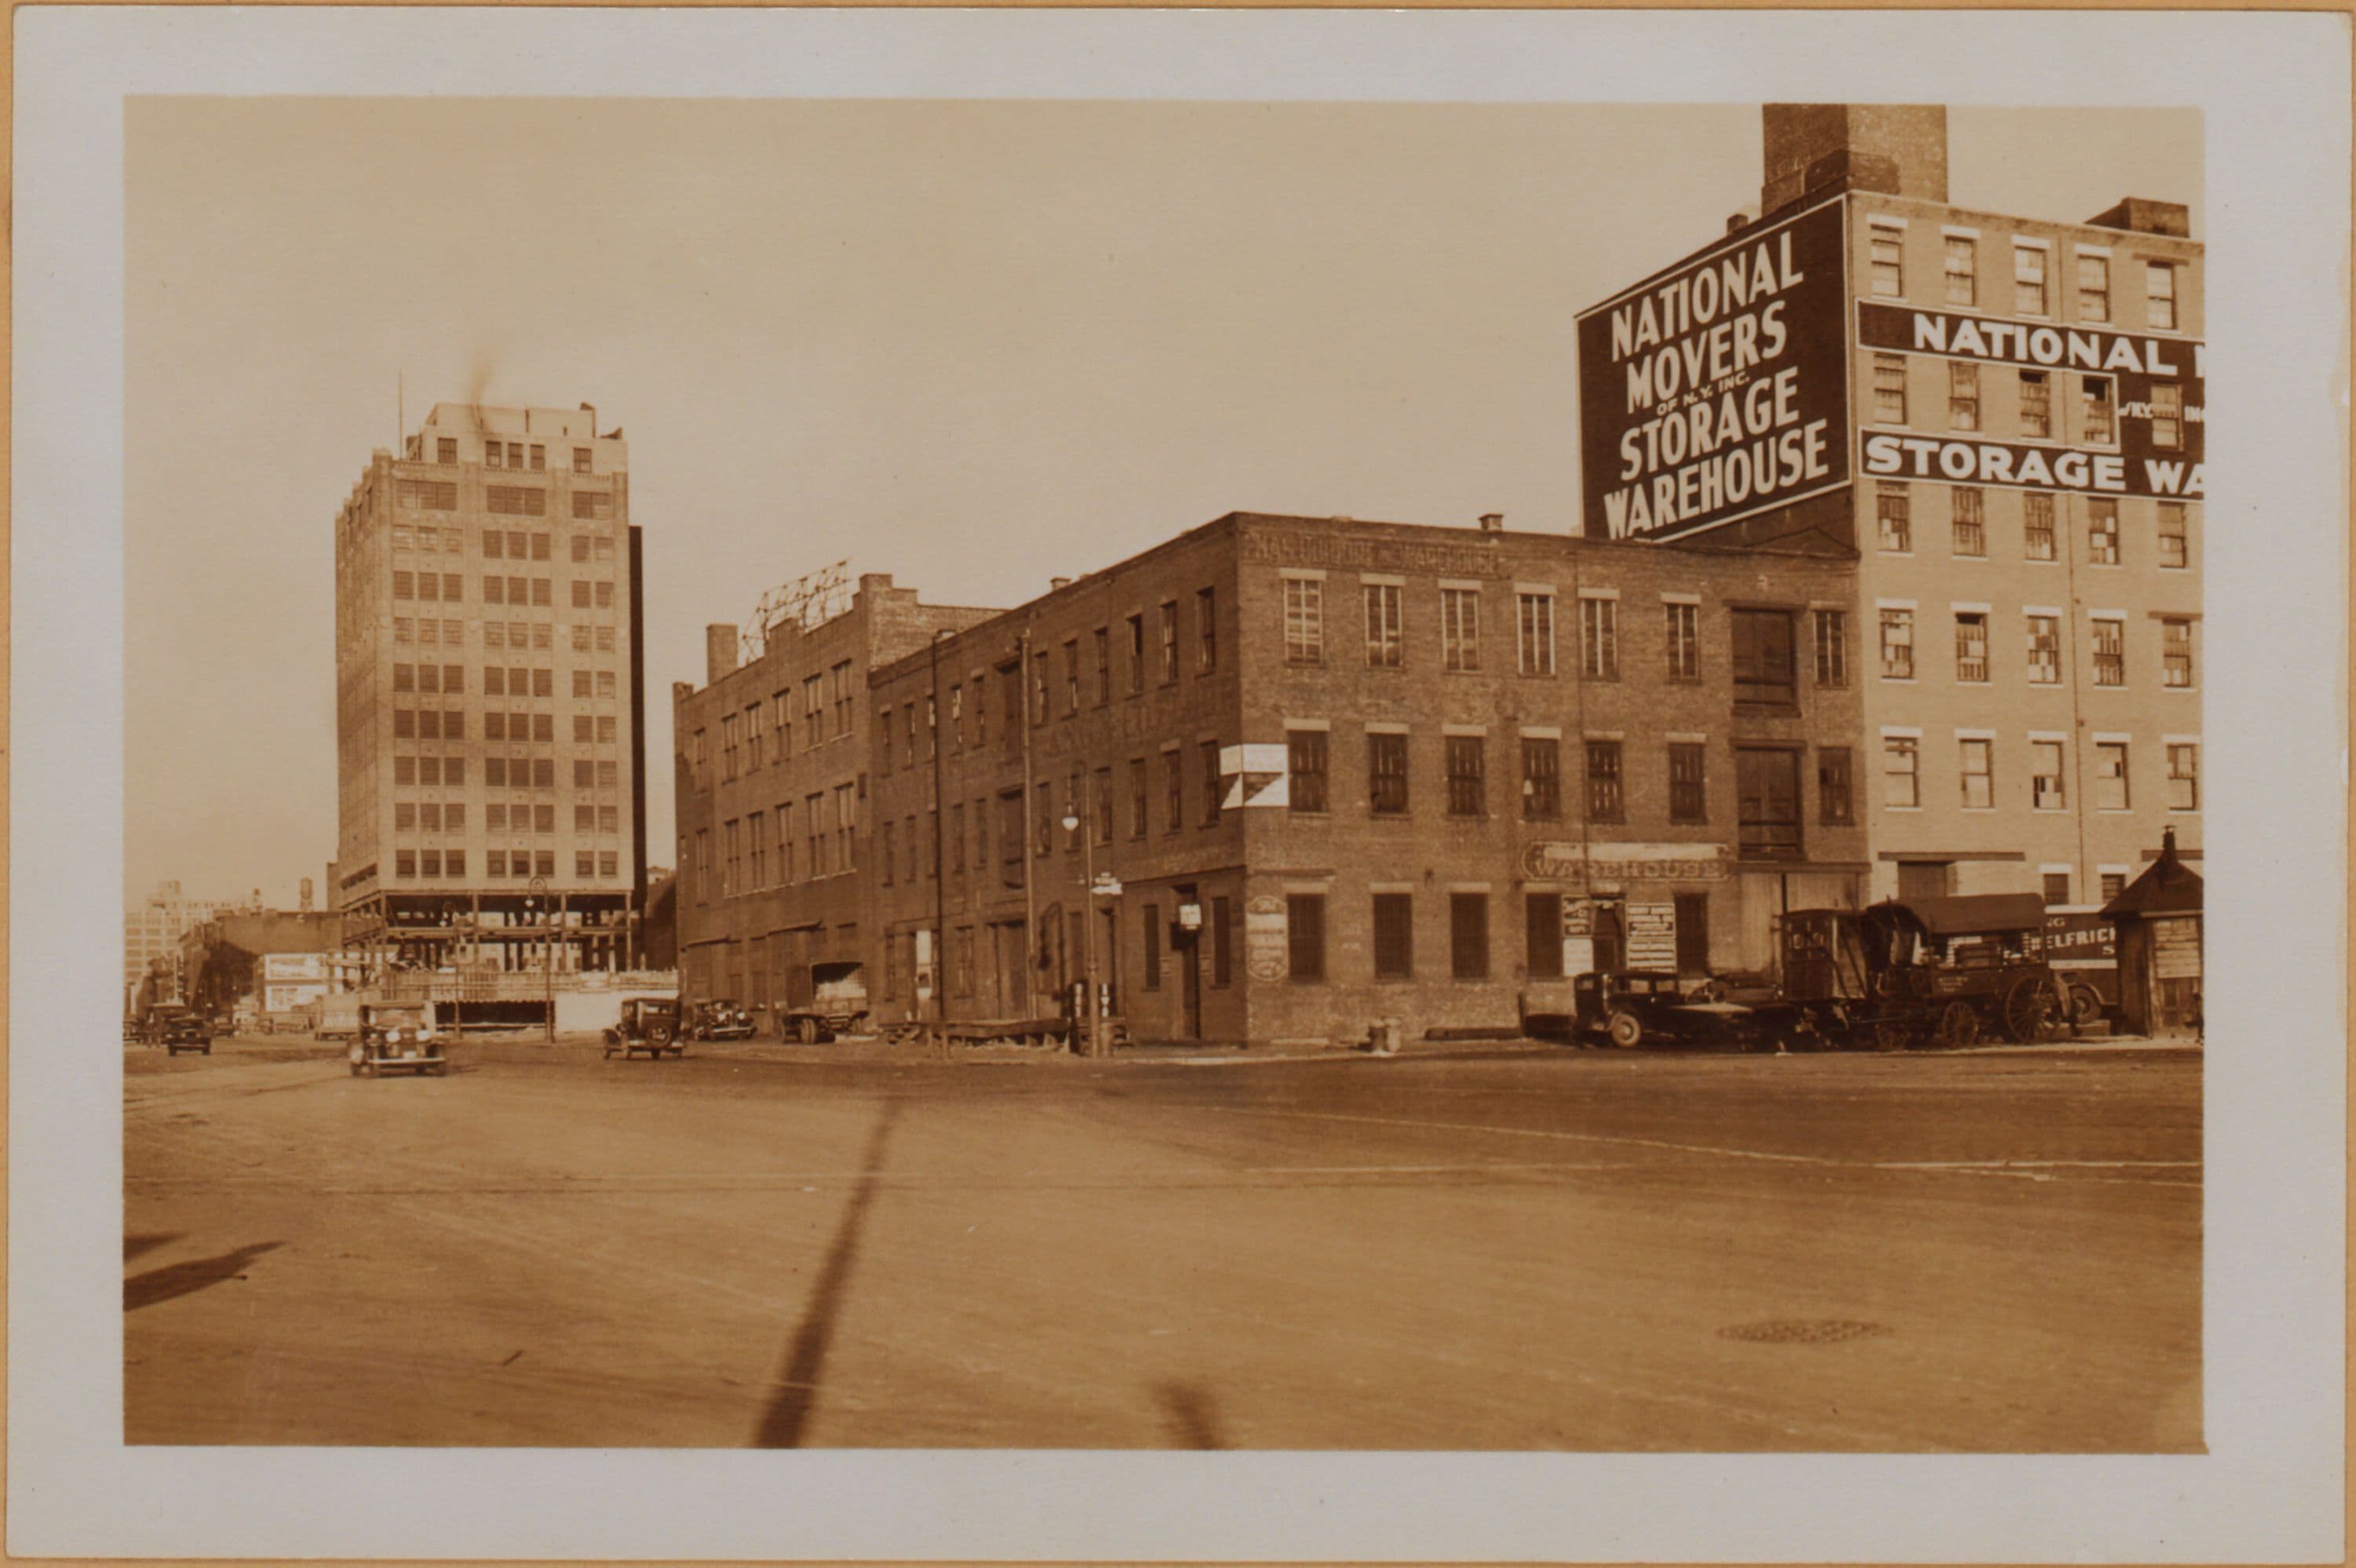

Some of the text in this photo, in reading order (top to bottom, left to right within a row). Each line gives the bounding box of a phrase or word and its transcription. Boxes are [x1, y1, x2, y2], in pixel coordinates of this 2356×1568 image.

[1612, 230, 1803, 362] NATIONAL
[1627, 301, 1787, 414] MOVERS
[1913, 313, 2179, 377] NATIONAL
[1620, 366, 1800, 481] STORAGE
[1657, 397, 1678, 416] OF
[1718, 370, 1750, 392] INC.
[1603, 418, 1829, 540] WAREHOUSE
[1865, 435, 2127, 492] STORAGE
[1535, 859, 1720, 878] WAREHOUSE
